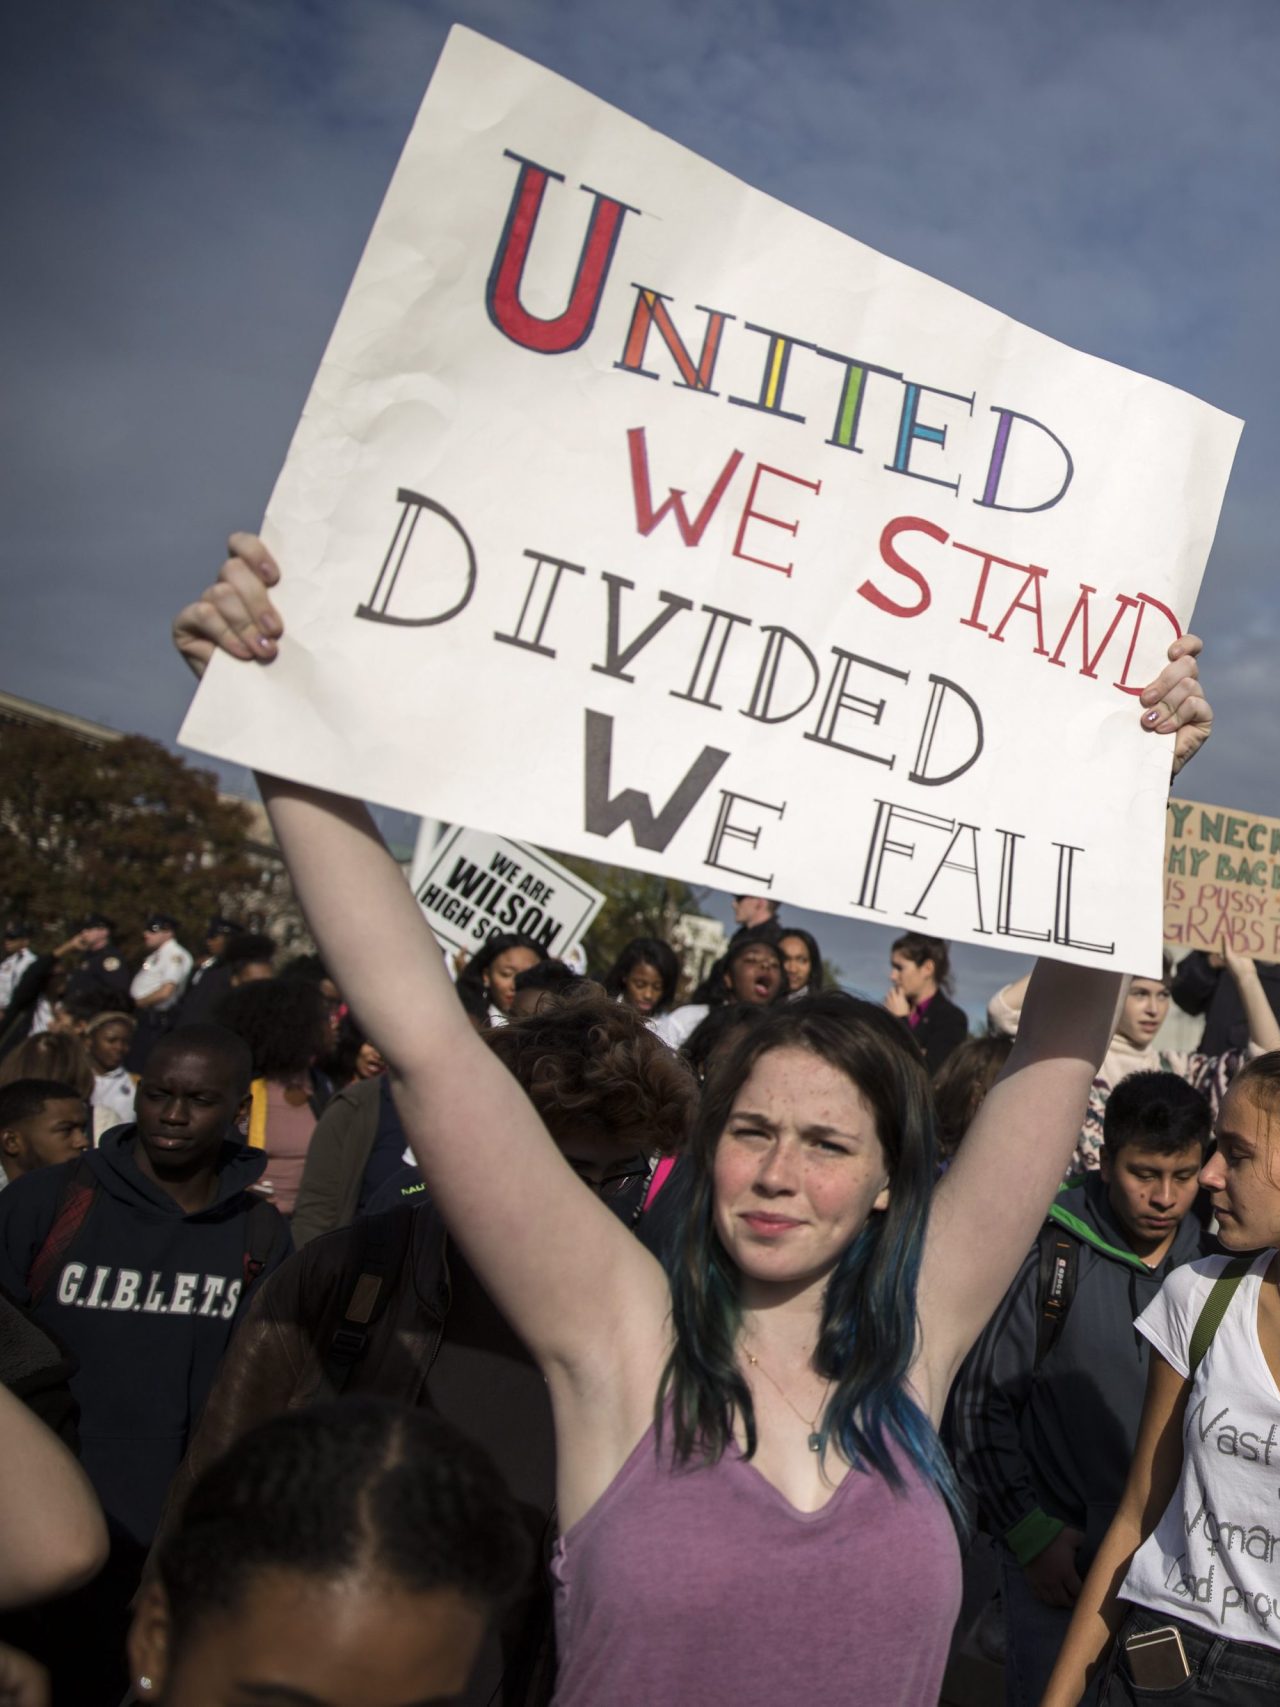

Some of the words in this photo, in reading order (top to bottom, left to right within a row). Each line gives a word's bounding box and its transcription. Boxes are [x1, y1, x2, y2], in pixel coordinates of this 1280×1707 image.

[485, 149, 1074, 512] UNITED
[626, 426, 821, 577] WE
[857, 516, 1181, 696] STAND
[354, 488, 984, 786] DIVIDED
[584, 708, 787, 889] WE
[851, 799, 1115, 955] FALL
[1168, 803, 1194, 838] Y
[489, 851, 522, 883] WE
[519, 874, 555, 907] ARE
[1168, 845, 1210, 877] MY
[421, 884, 475, 929] HIGH
[447, 857, 562, 946] WILSON
[1165, 878, 1186, 901] IS
[1198, 884, 1269, 916] PUSSY
[1163, 903, 1265, 954] GRABS
